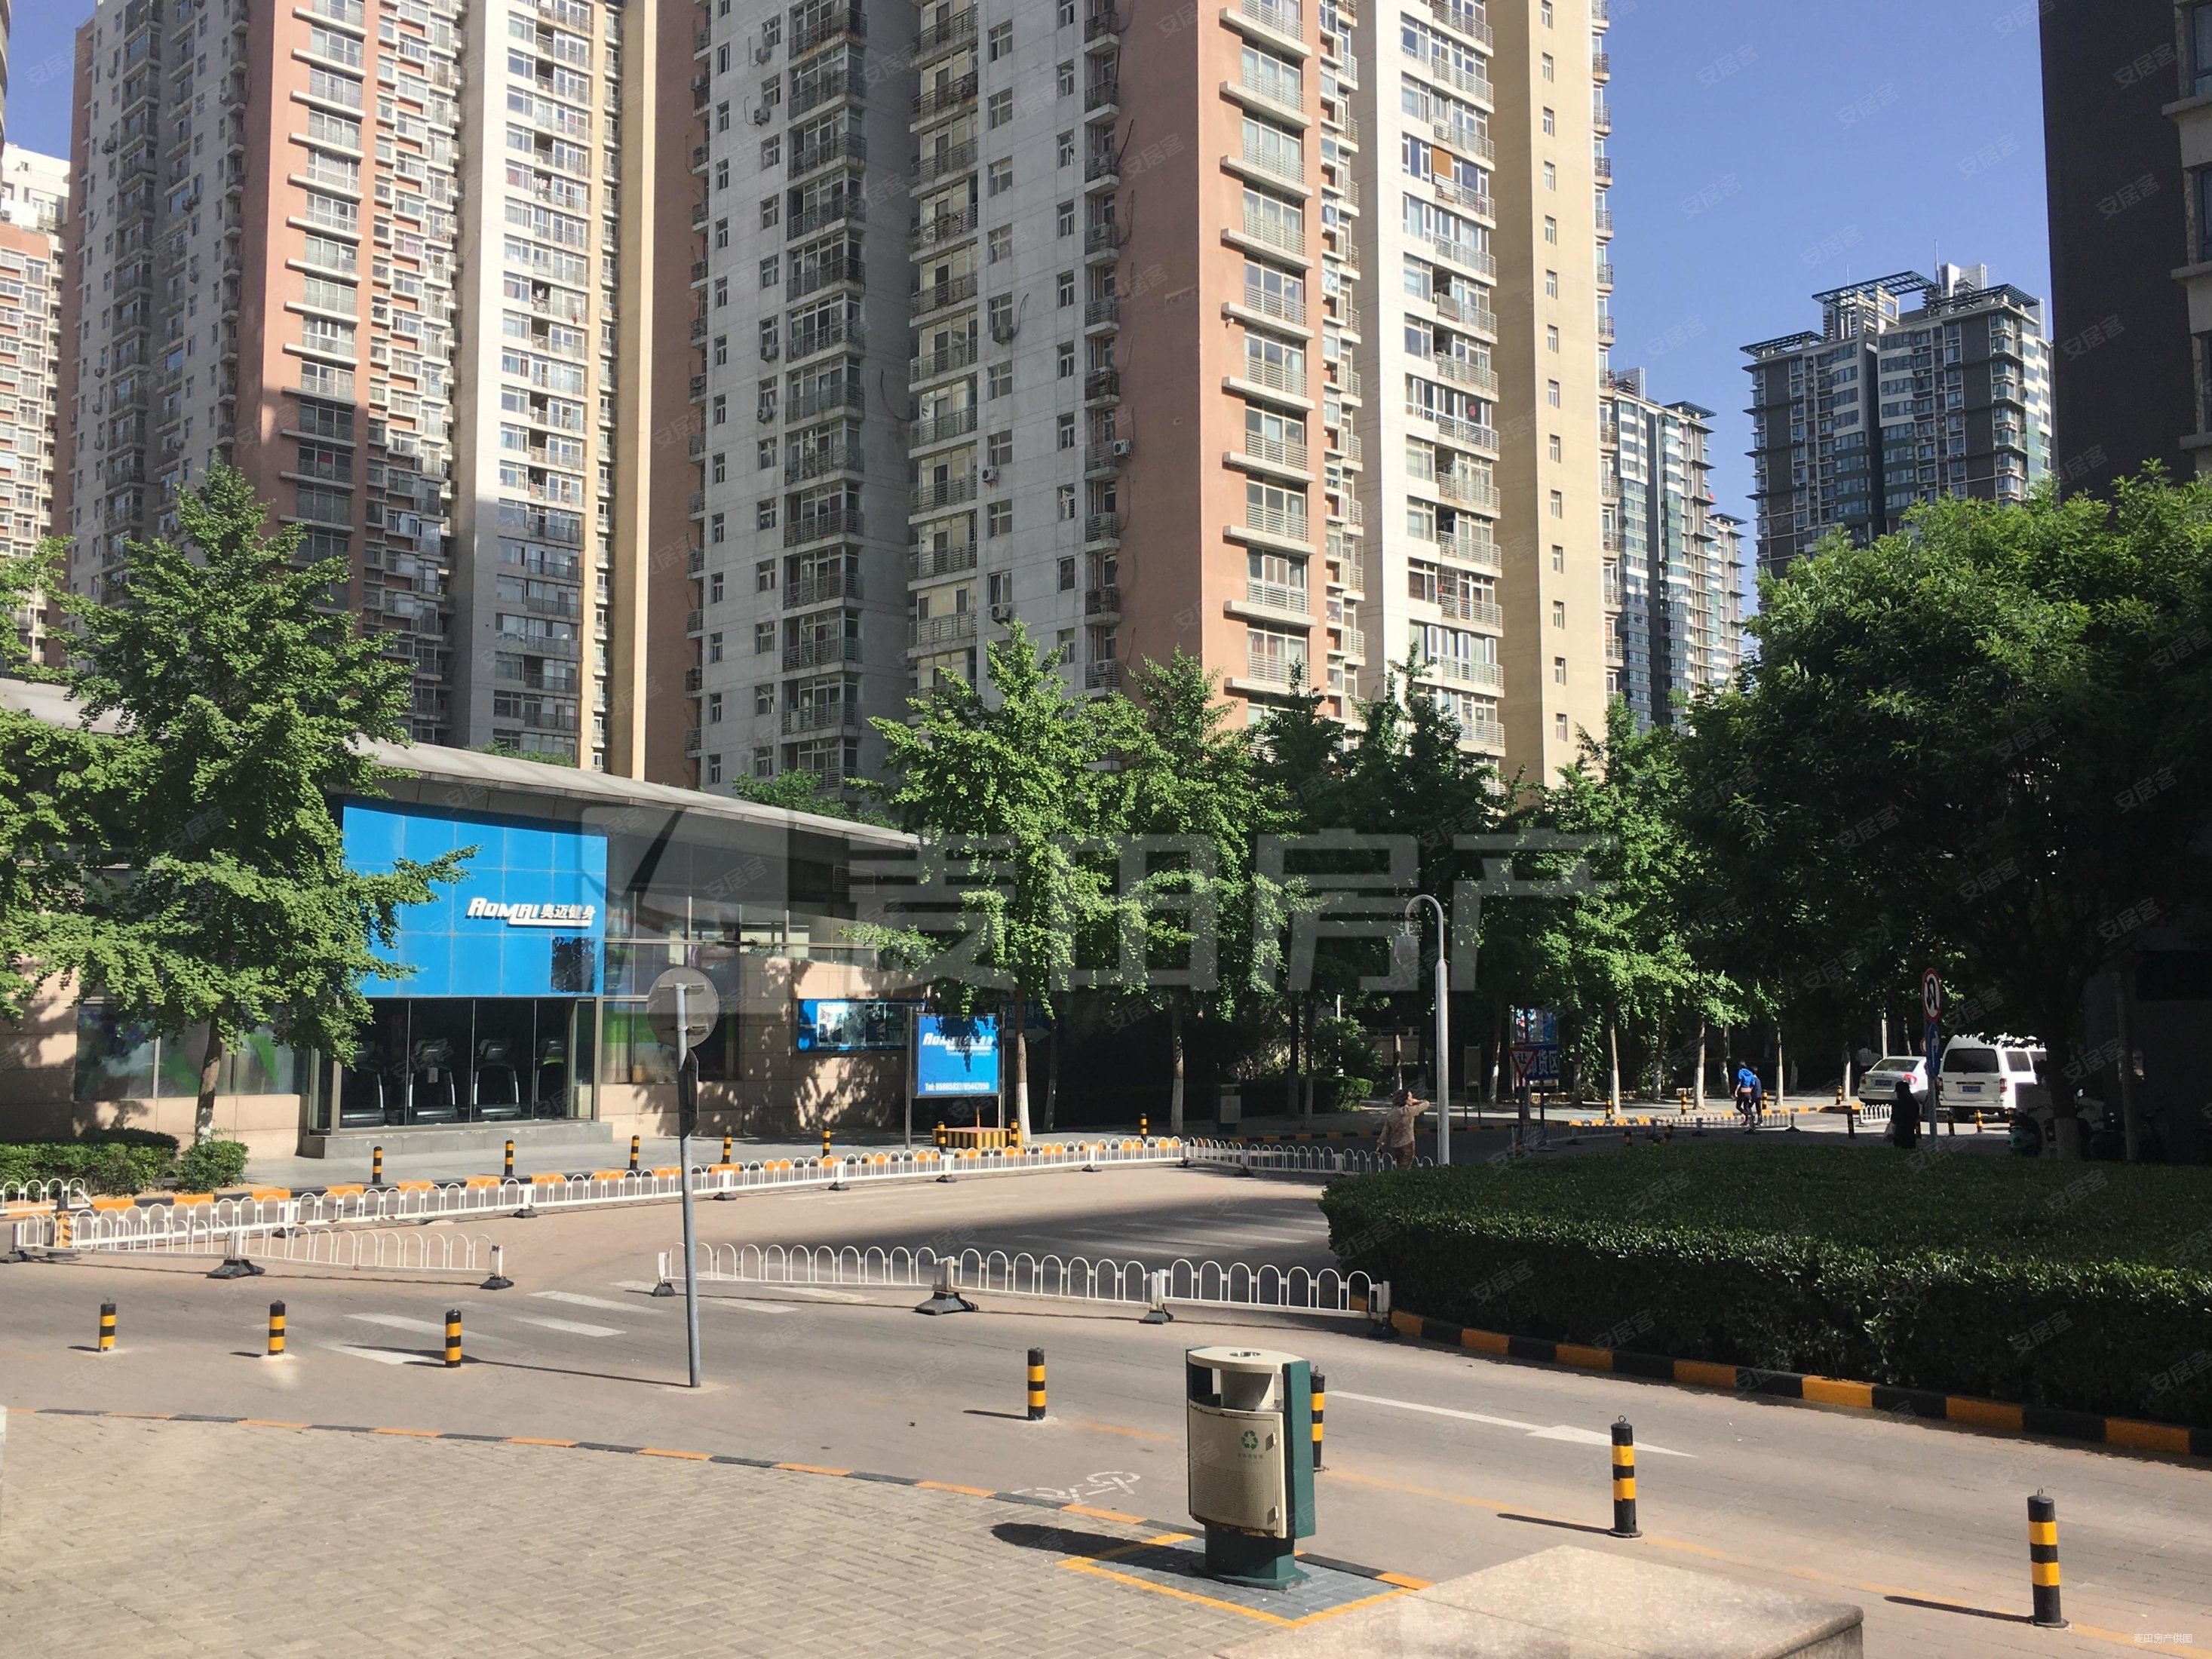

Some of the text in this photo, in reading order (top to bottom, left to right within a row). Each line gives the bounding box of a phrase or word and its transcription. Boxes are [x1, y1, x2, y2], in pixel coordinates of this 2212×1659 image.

[540, 903, 596, 920] 奥迈健身
[1517, 1053, 1527, 1064] 让
